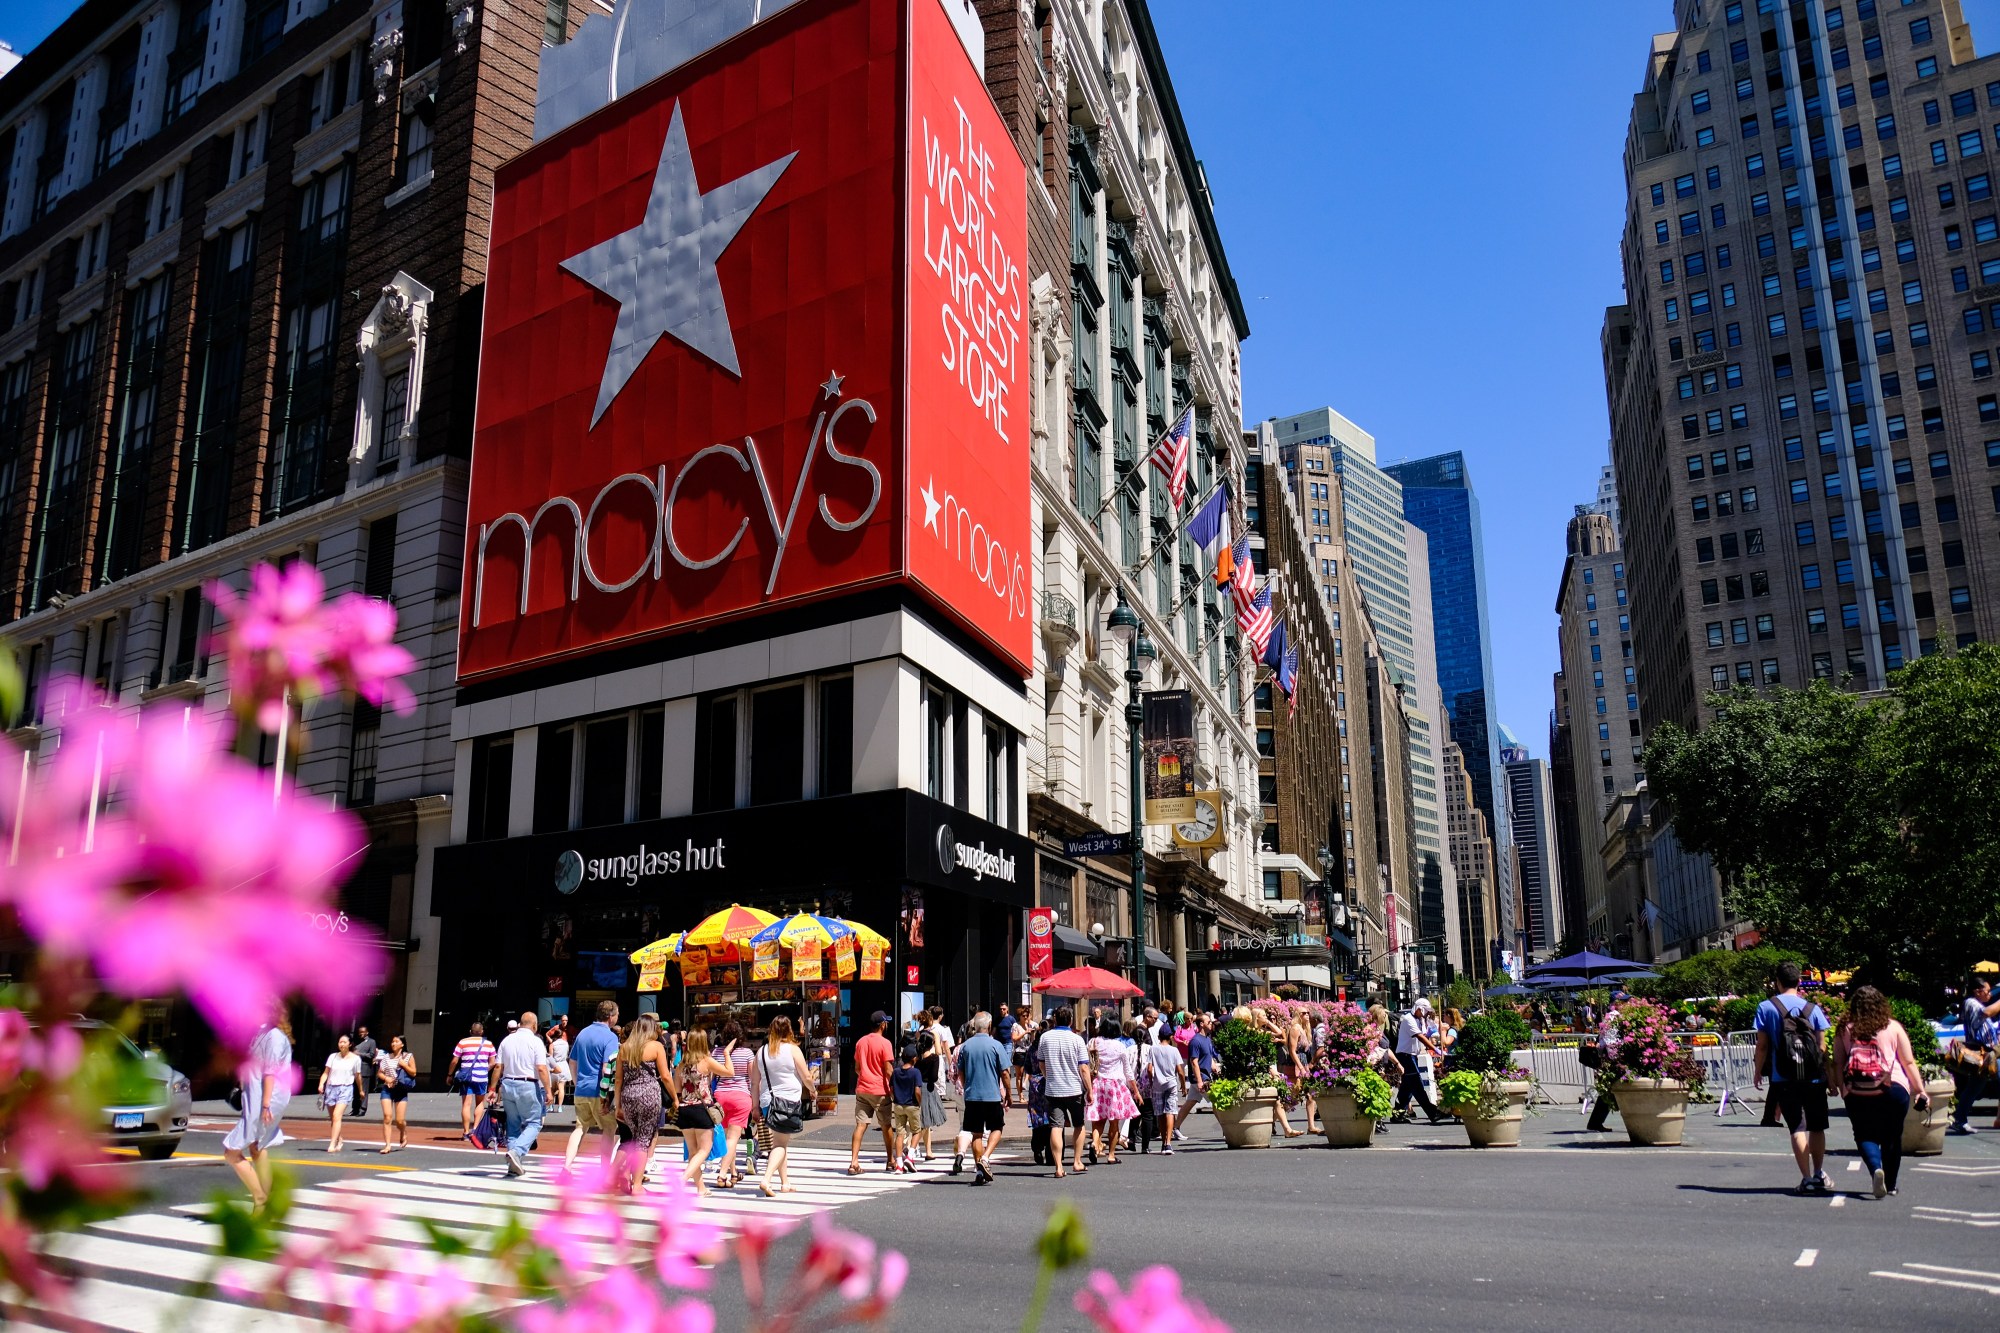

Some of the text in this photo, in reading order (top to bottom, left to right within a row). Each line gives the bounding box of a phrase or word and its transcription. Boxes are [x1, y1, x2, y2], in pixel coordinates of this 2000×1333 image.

[923, 115, 1021, 322] WORLD'S
[953, 95, 996, 219] THE
[924, 194, 1020, 384] LARGEST
[941, 303, 1010, 445] STORE
[473, 370, 882, 627] macy's
[944, 490, 1026, 622] macy's
[588, 838, 726, 887] sunglass hut
[955, 840, 1016, 884] sunglass hut
[1069, 839, 1122, 853] West 34th St
[303, 910, 349, 937] acy's
